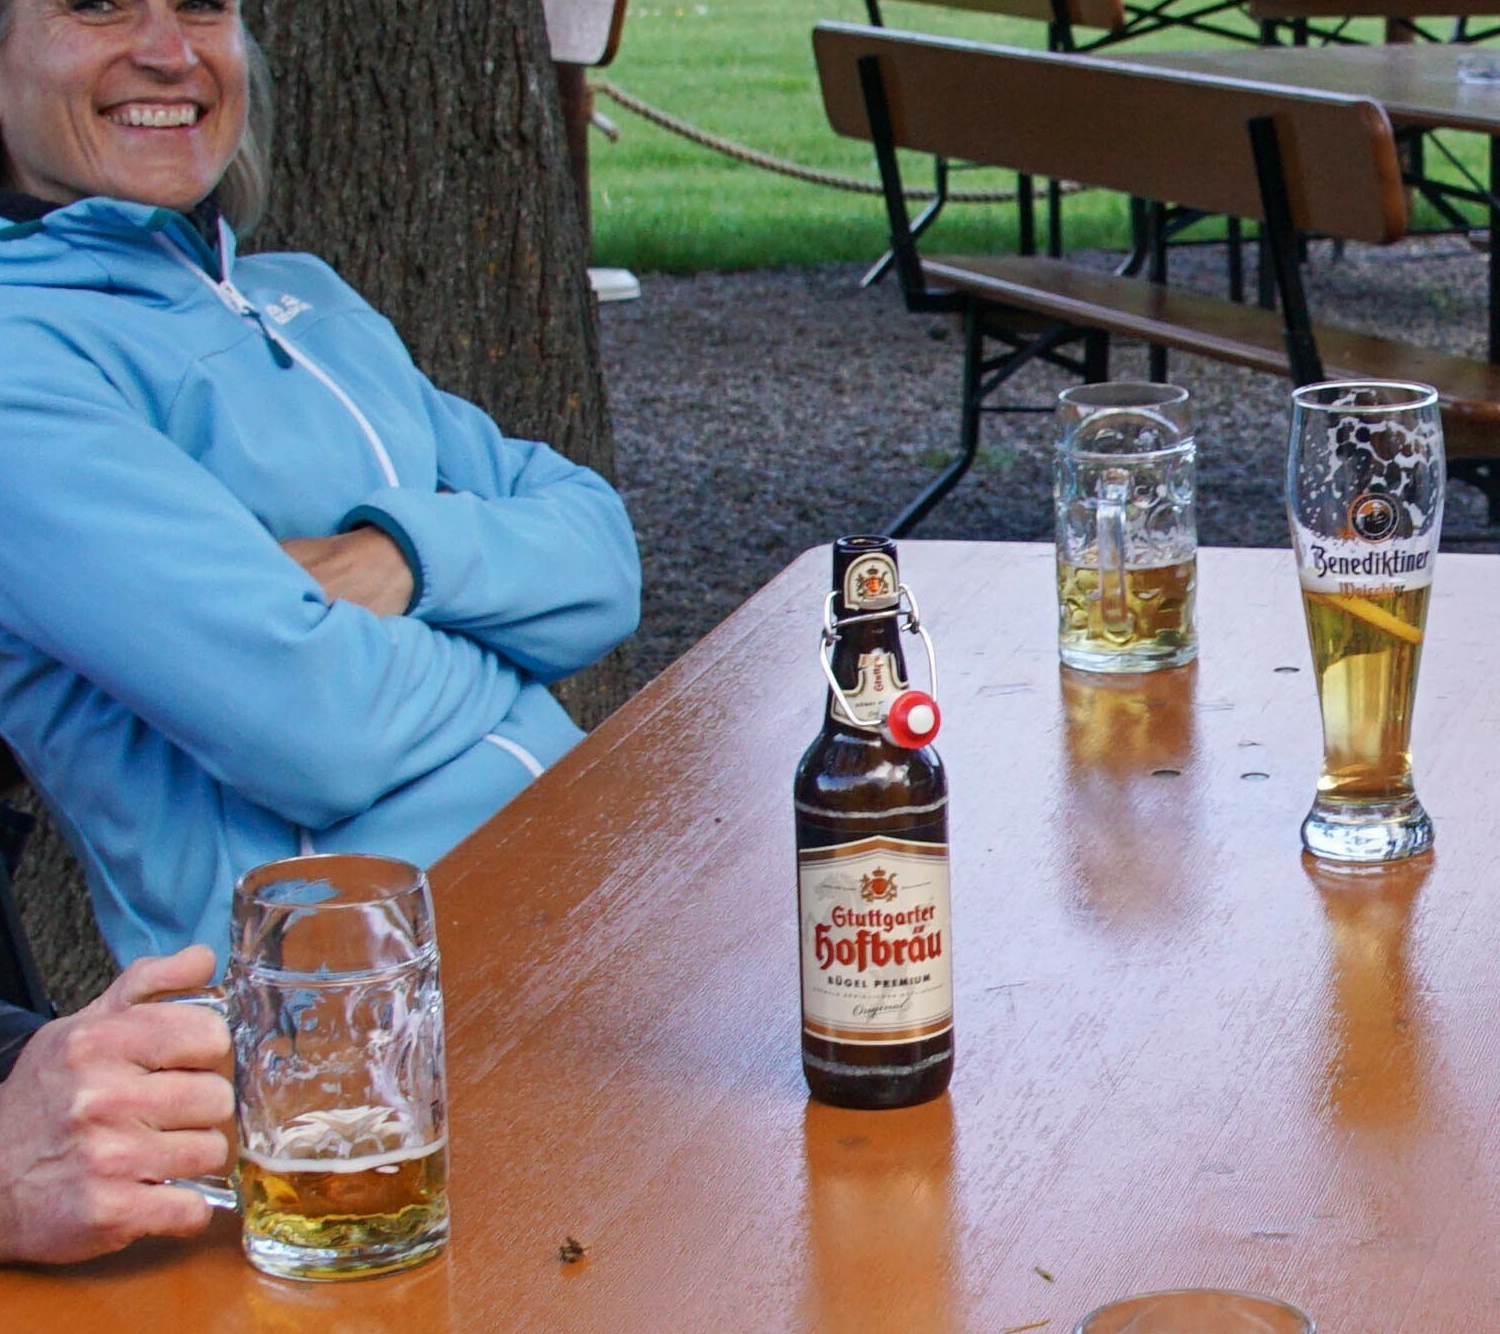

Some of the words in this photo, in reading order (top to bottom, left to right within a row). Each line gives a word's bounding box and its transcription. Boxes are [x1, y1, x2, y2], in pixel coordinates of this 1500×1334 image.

[1310, 544, 1430, 579] Benediktiner
[831, 905, 936, 933] Stuttgarter
[874, 973, 931, 988] PREMIUM
